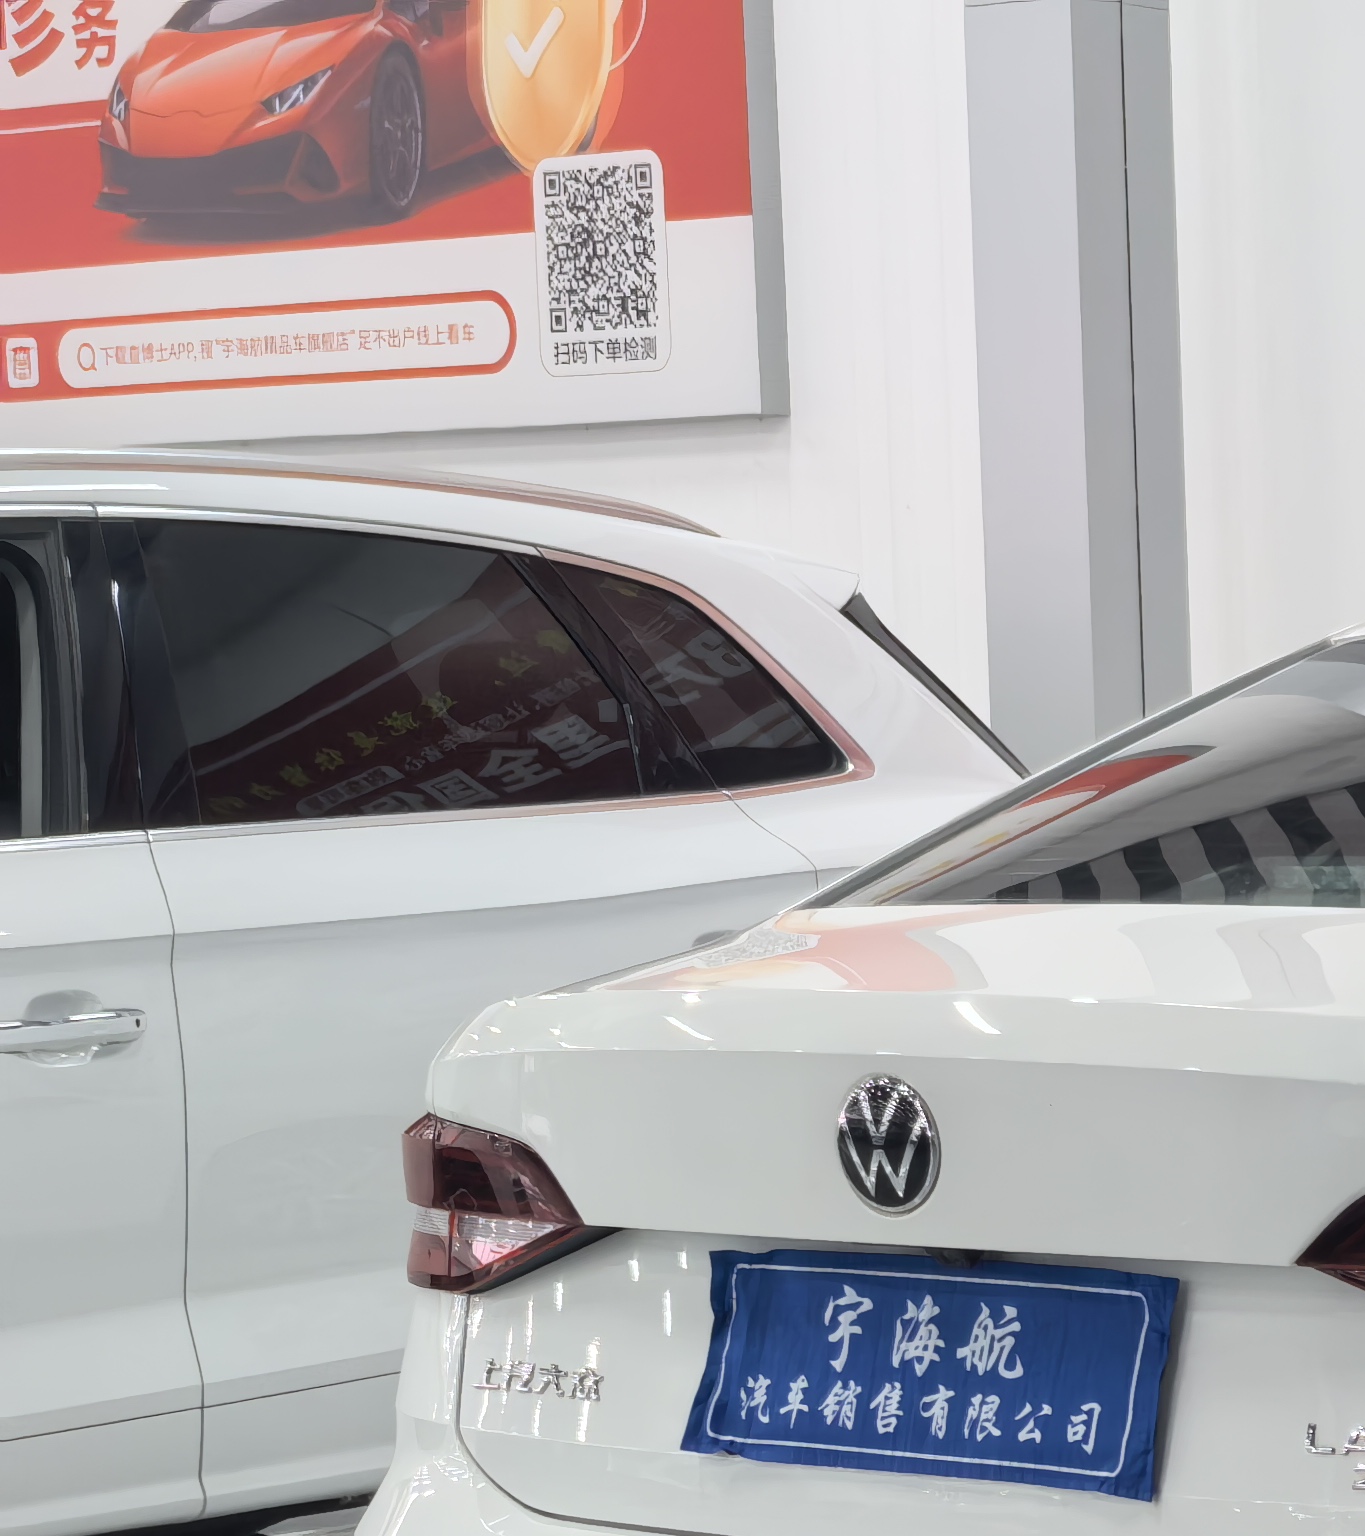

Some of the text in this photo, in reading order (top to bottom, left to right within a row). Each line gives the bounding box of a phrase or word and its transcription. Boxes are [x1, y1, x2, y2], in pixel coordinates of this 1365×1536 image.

[554, 336, 657, 366] 扫码下单检测
[824, 1284, 1025, 1379] 宇海航
[740, 1373, 1102, 1455] 汽车销售有限公司
